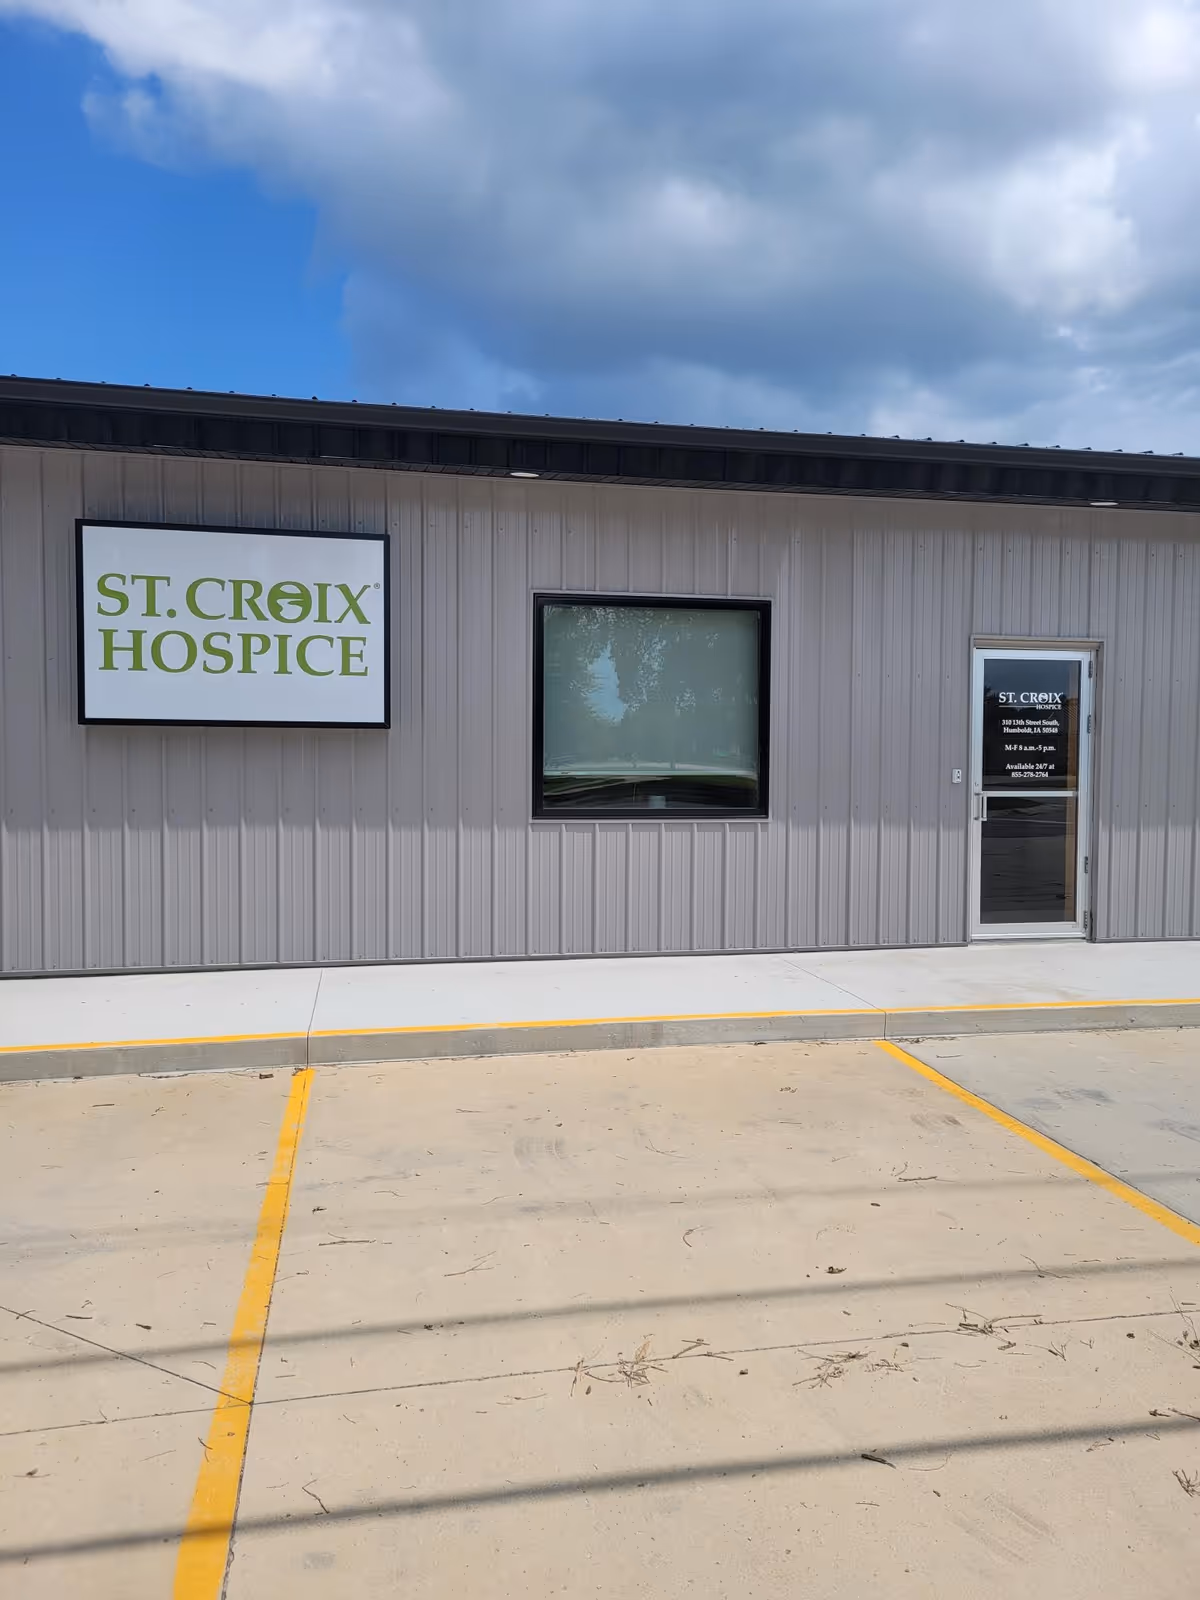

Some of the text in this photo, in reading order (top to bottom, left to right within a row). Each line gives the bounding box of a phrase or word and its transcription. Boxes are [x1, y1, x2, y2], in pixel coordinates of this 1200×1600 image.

[97, 573, 177, 618] ST.
[97, 628, 369, 677] HOSPICE
[998, 692, 1017, 703] ST.
[1043, 745, 1056, 753] p.m.
